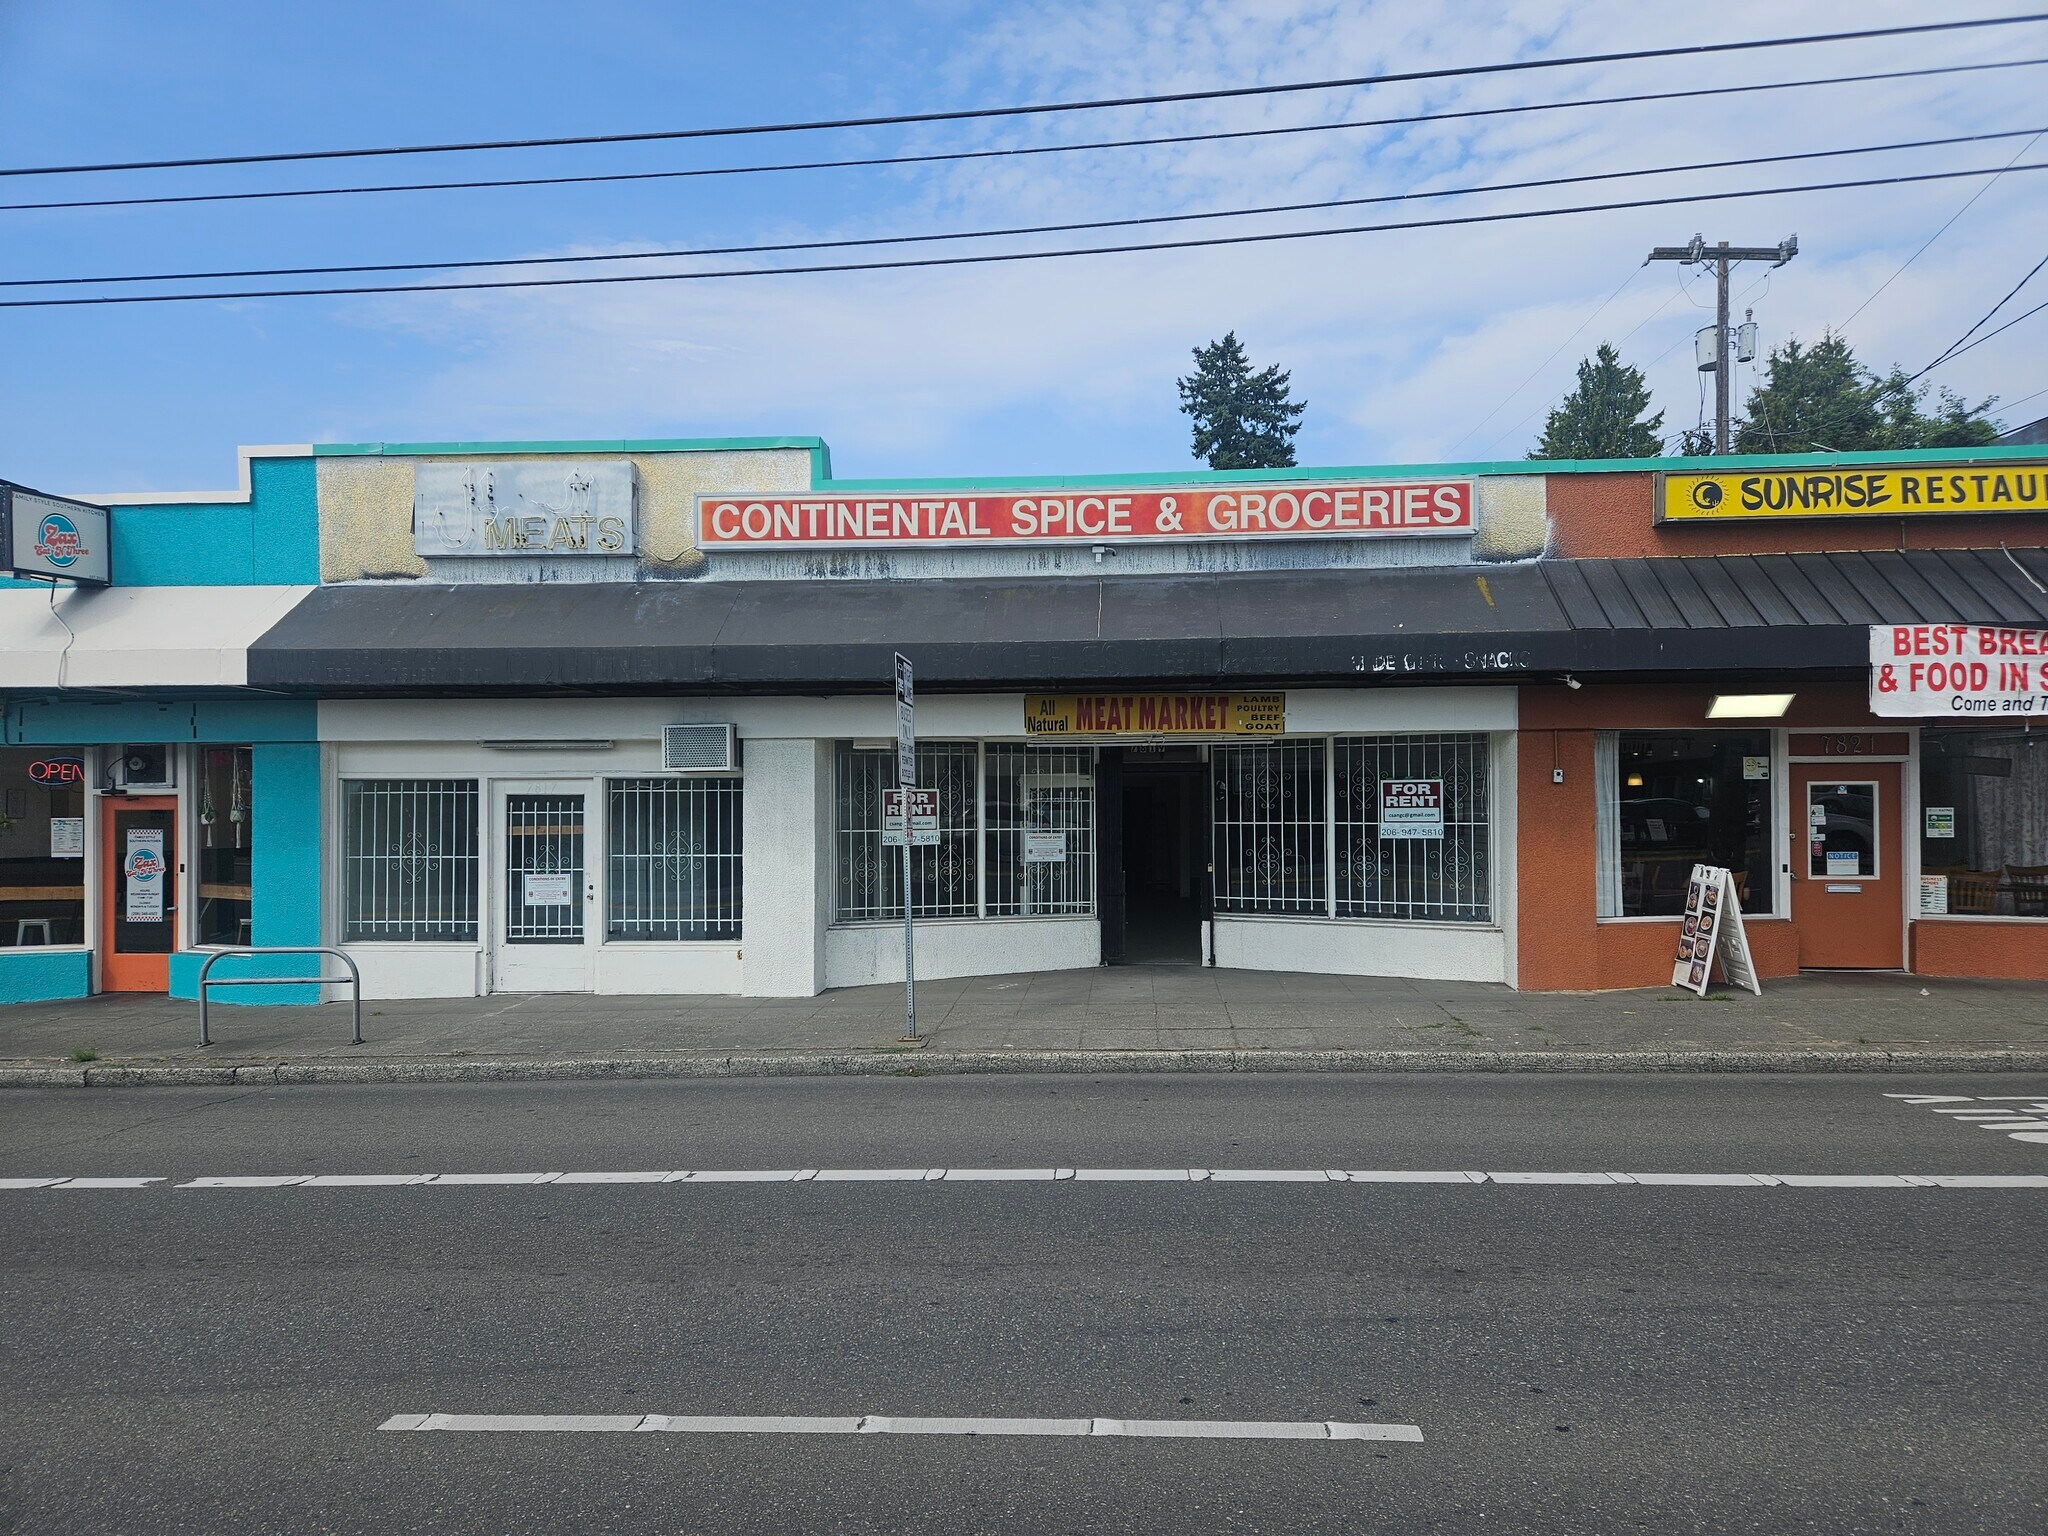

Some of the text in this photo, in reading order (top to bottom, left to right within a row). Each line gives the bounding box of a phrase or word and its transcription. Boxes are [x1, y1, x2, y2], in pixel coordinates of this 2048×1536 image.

[1741, 474, 2048, 511] SUNRISE RESTAU
[711, 486, 1462, 540] CONTINENTAL SPICE & GROCERIES
[44, 524, 77, 547] Zax
[484, 515, 625, 551] MEATS
[1893, 626, 1968, 657] BEST
[1877, 663, 1898, 693] &
[1909, 662, 1988, 692] FOOD
[1999, 662, 2029, 692] IN
[1040, 700, 1055, 716] All
[1076, 696, 1229, 730] MEAT MARKET
[1951, 695, 1997, 711] Come
[2002, 695, 2034, 712] and
[1027, 716, 1068, 732] Natural
[1820, 735, 1876, 754] 7821
[28, 761, 84, 781] OPEN
[1391, 783, 1431, 795] FOR
[887, 804, 935, 815] RNT
[1385, 795, 1438, 807] RENT
[883, 835, 940, 843] 206-7-5810
